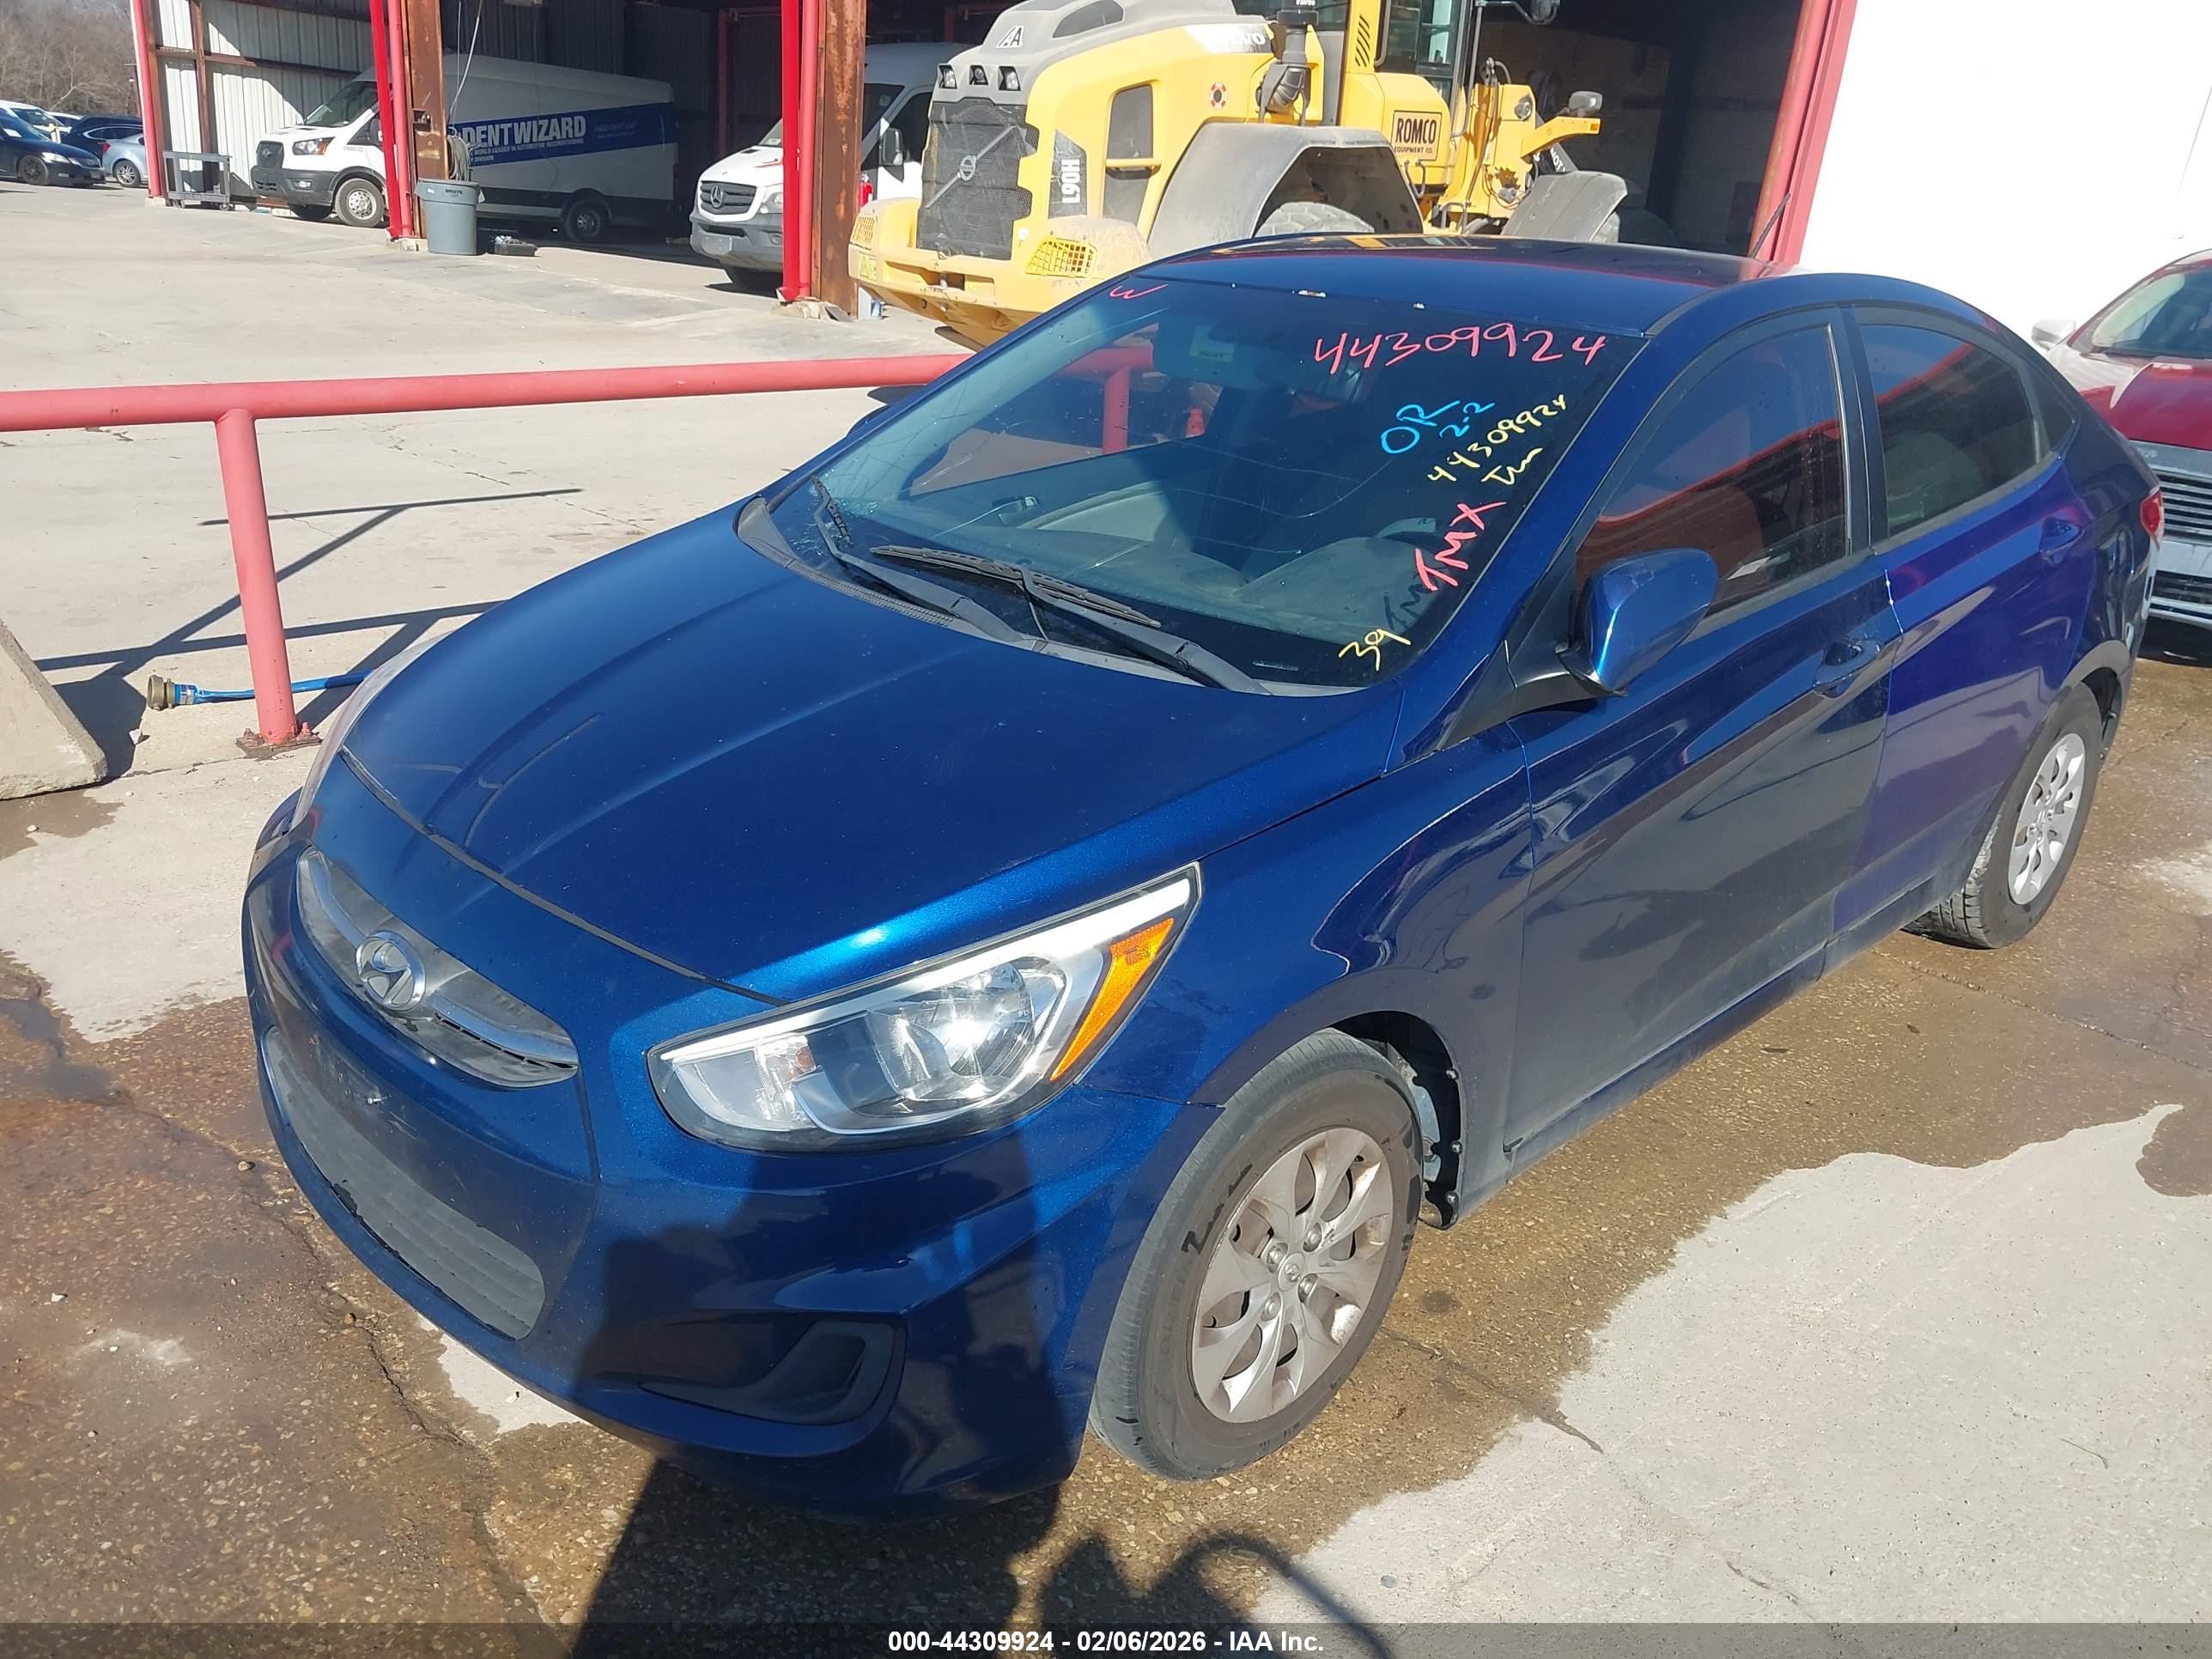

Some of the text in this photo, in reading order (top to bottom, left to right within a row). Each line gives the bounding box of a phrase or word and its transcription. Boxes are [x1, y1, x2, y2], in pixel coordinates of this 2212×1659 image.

[462, 115, 586, 148] DENT WIZARD
[1395, 117, 1437, 144] ROMCO
[1395, 145, 1425, 154] EQUIPMENT
[1060, 159, 1081, 204] L90H
[1313, 321, 1607, 375] 44309924
[1426, 392, 1567, 482] 44309924
[1413, 501, 1508, 592] TMX
